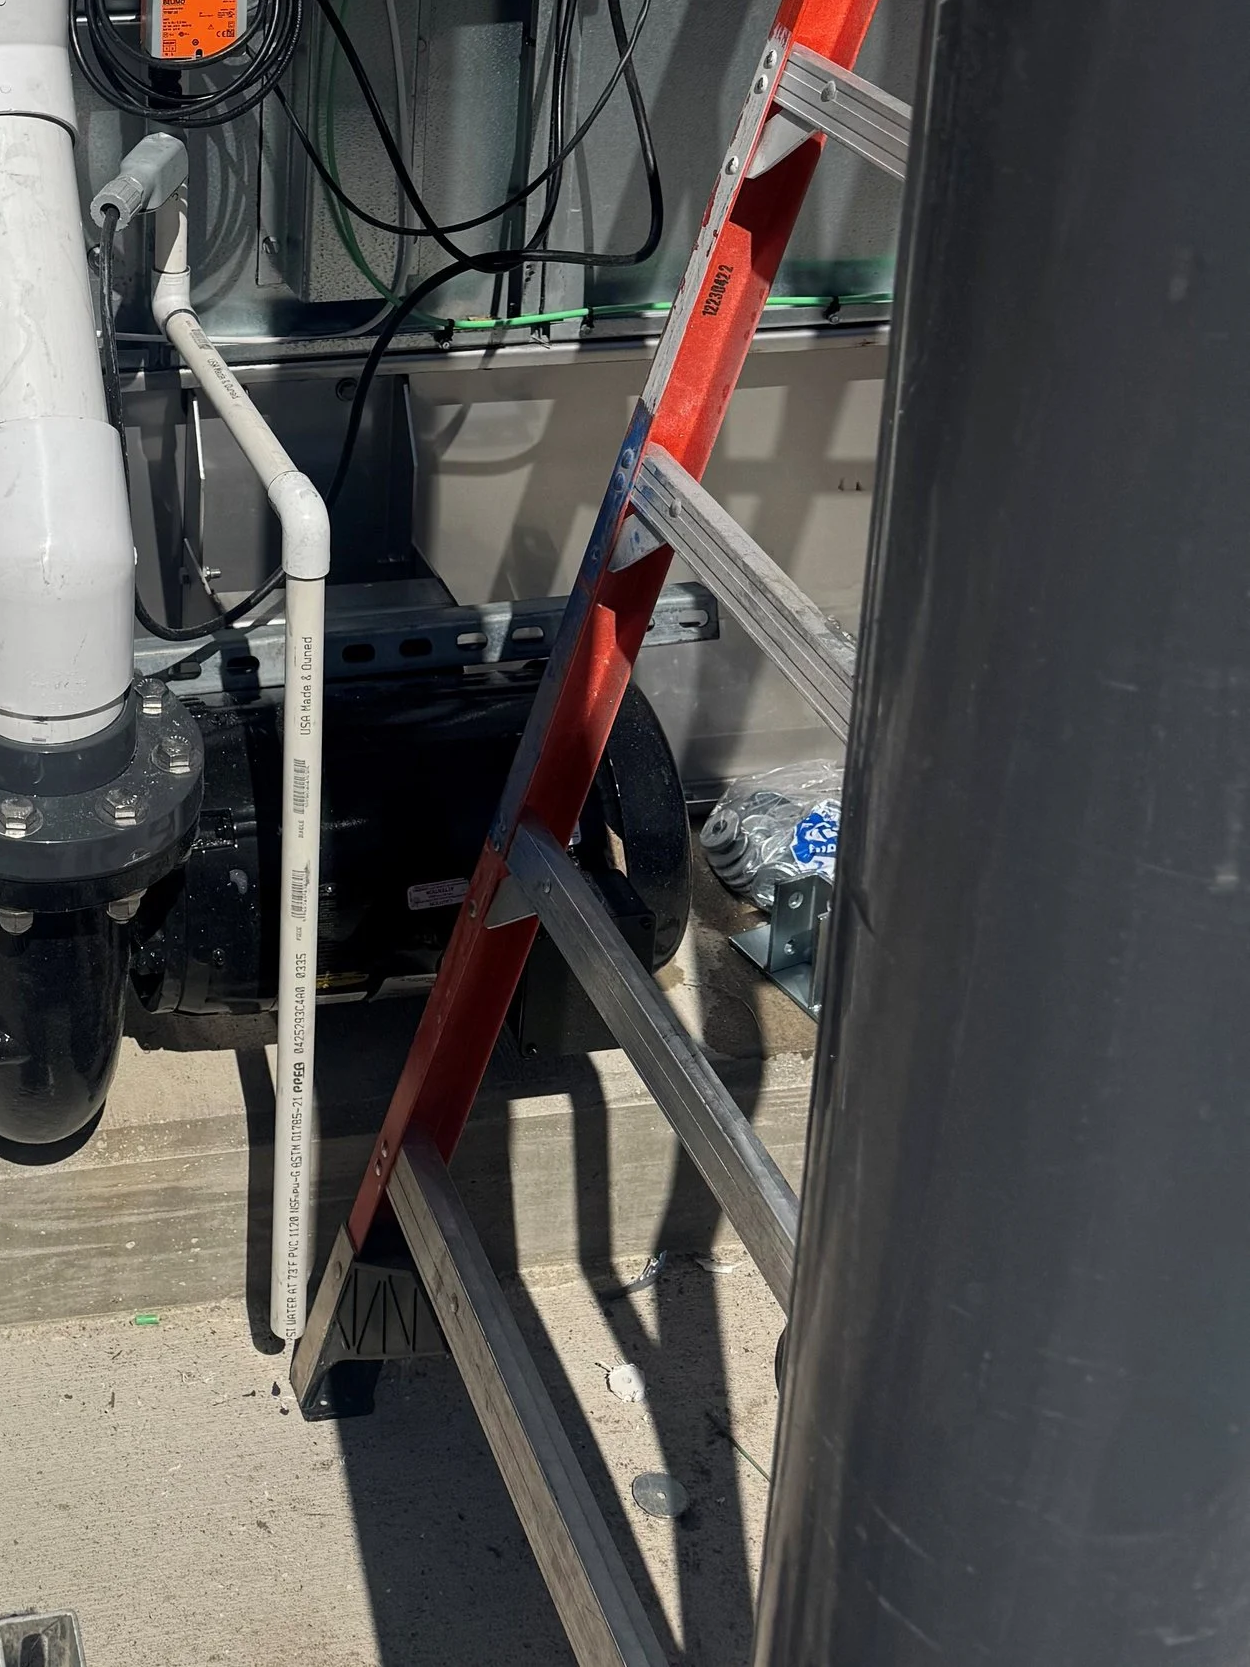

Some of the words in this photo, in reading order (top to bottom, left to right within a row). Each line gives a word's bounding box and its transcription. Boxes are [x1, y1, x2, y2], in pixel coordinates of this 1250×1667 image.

[702, 265, 734, 316] 12230422
[301, 636, 312, 671] Owned
[301, 684, 311, 712] Made
[300, 715, 311, 735] USA
[291, 1144, 302, 1169] ASTM
[288, 1240, 299, 1258] PVC
[287, 1283, 297, 1294] AT
[286, 1297, 297, 1325] WATER
